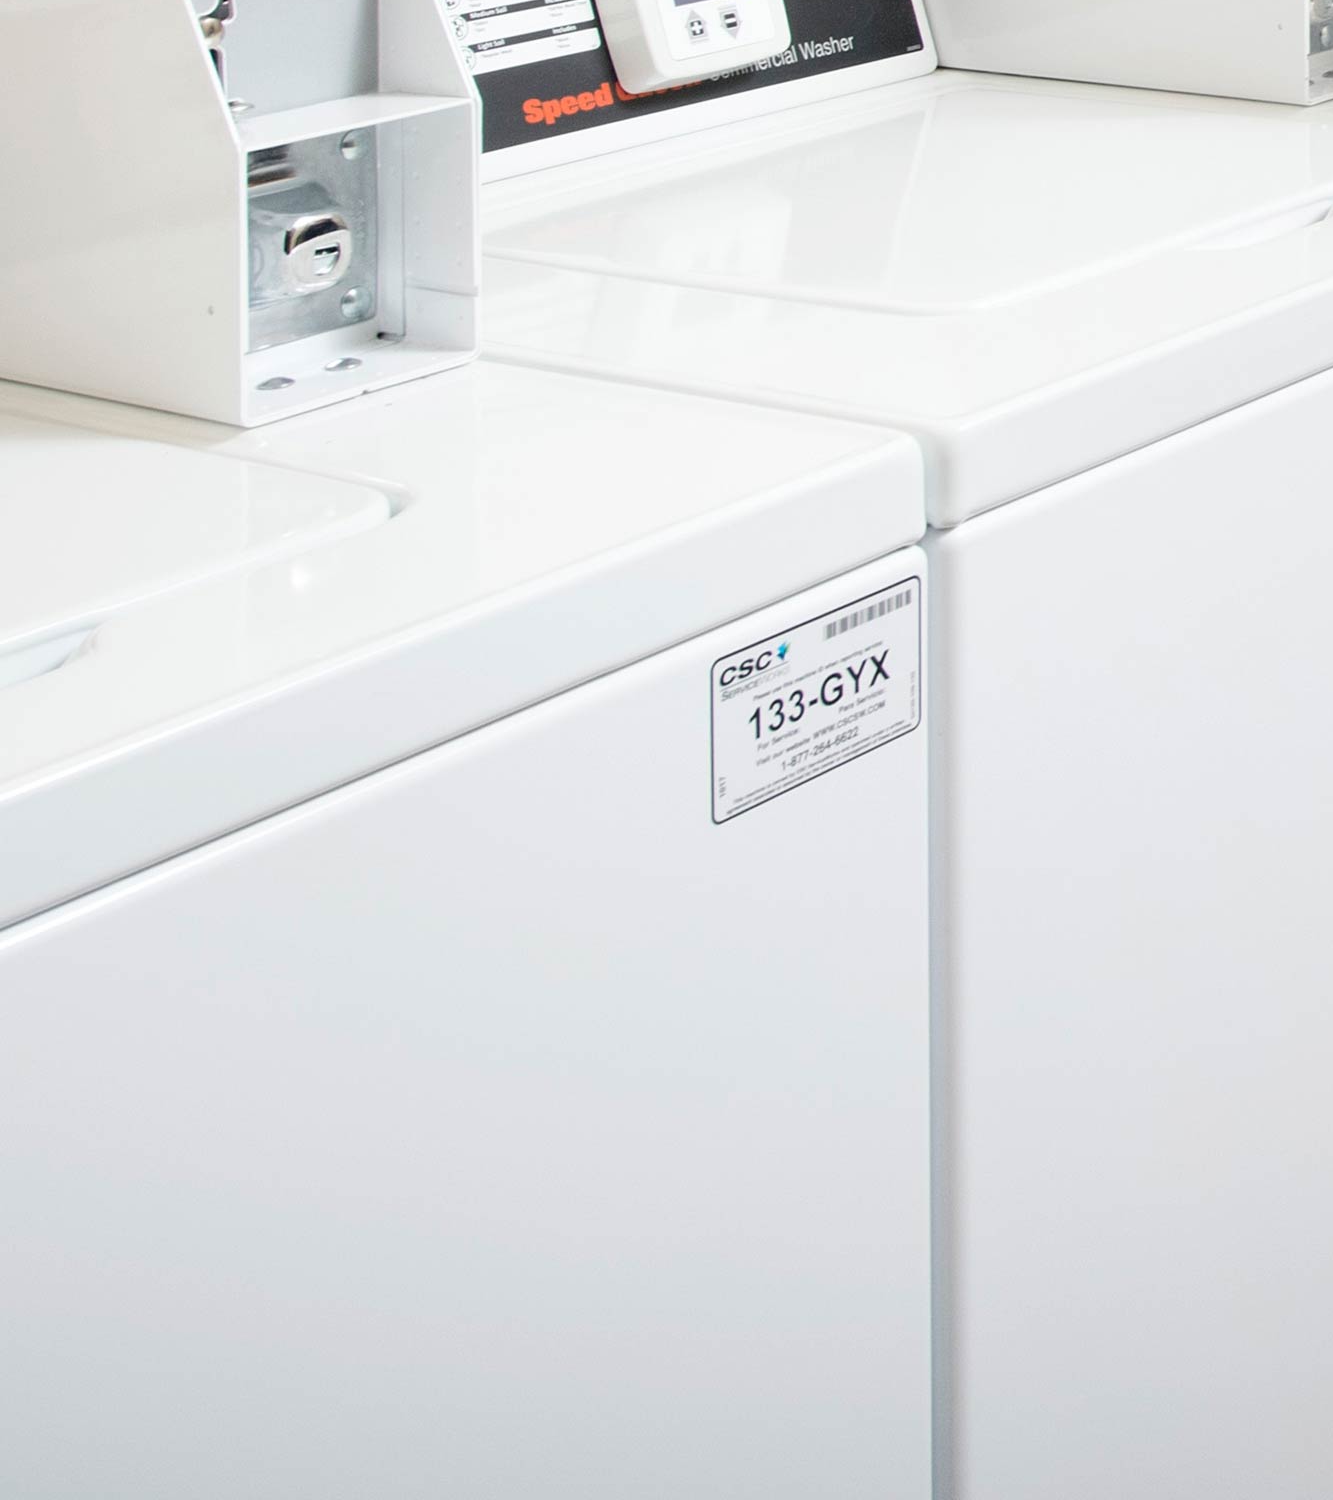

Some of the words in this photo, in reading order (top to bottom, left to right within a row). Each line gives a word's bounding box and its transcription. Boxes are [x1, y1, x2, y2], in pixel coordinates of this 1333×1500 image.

[522, 82, 615, 125] Speed
[799, 36, 854, 61] Washer
[719, 650, 772, 687] CSC
[749, 648, 890, 739] 133-GYX
[838, 701, 853, 713] Para
[812, 699, 885, 740] WWW.CSCSW.COM
[757, 741, 768, 752] For
[782, 725, 858, 771] 1-877-264-6622
